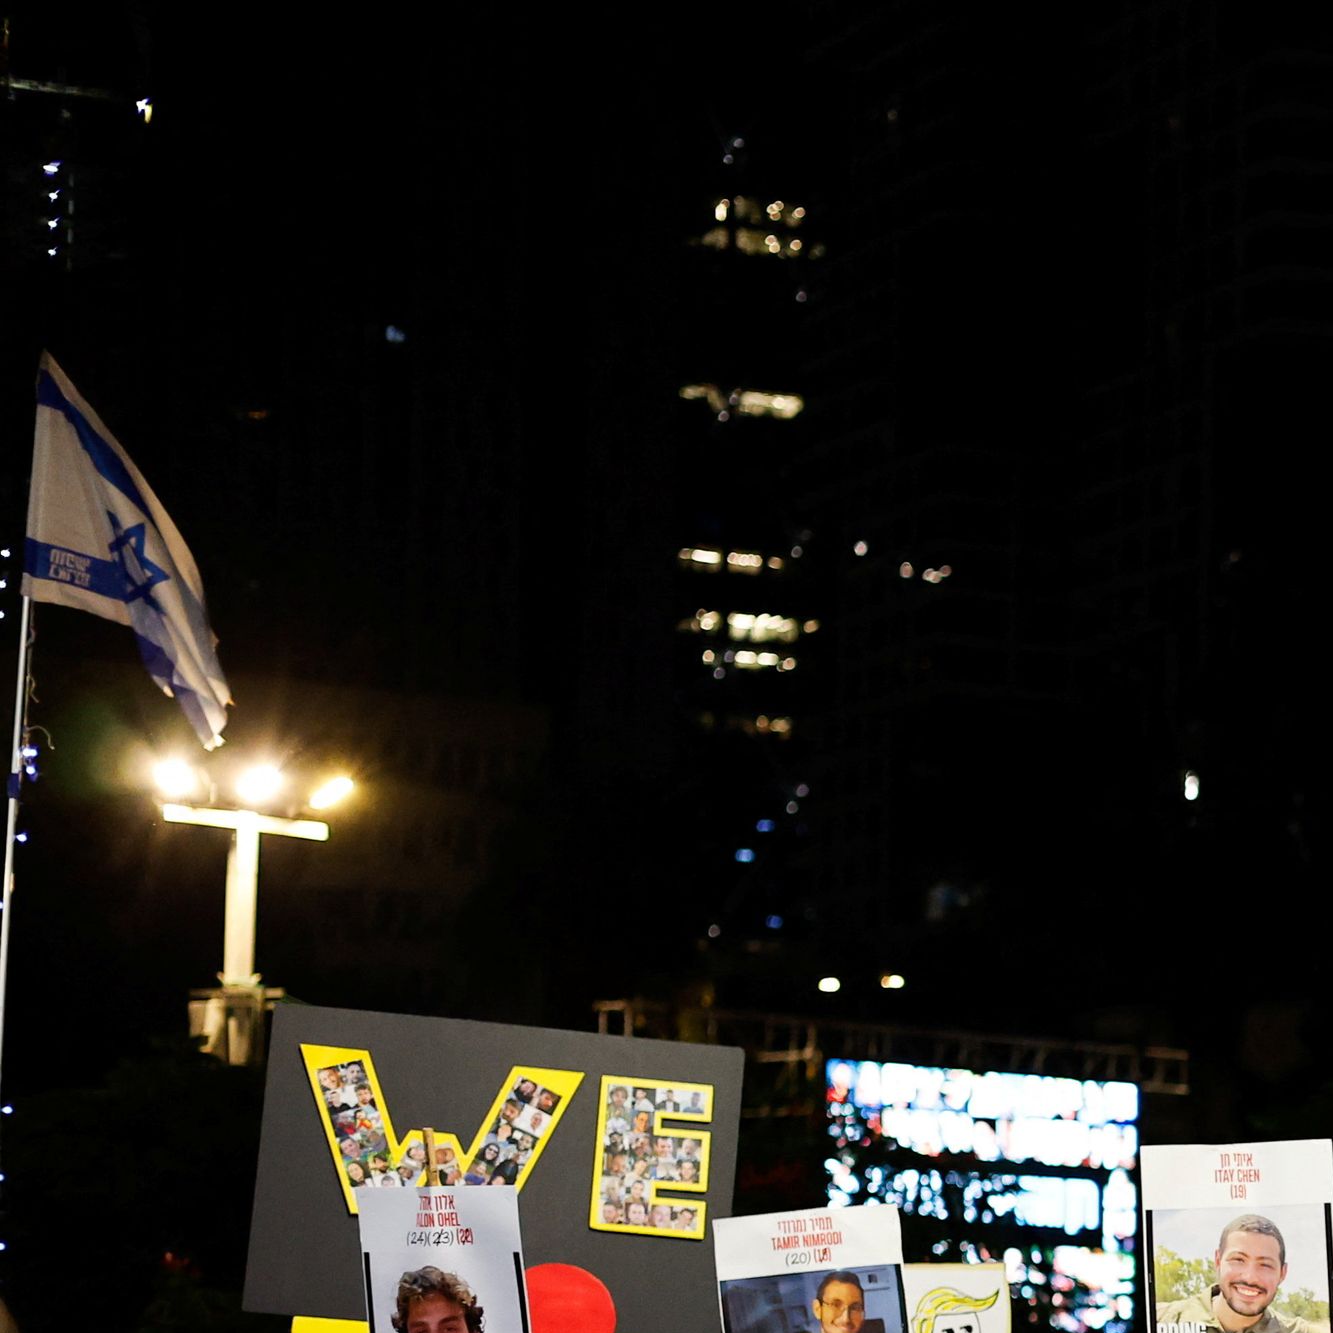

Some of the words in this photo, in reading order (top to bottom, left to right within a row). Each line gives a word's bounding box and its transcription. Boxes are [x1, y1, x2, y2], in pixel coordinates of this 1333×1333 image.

[300, 1044, 714, 1240] WE
[1215, 1169, 1234, 1183] ITAY
[1237, 1169, 1260, 1183] CHEN
[1230, 1184, 1247, 1200] (19)
[416, 1213, 435, 1227] ALON
[437, 1212, 460, 1227] OHEL
[771, 1235, 800, 1251] TAMIR
[803, 1231, 842, 1248] NIMRODI
[785, 1251, 811, 1267] (20)
